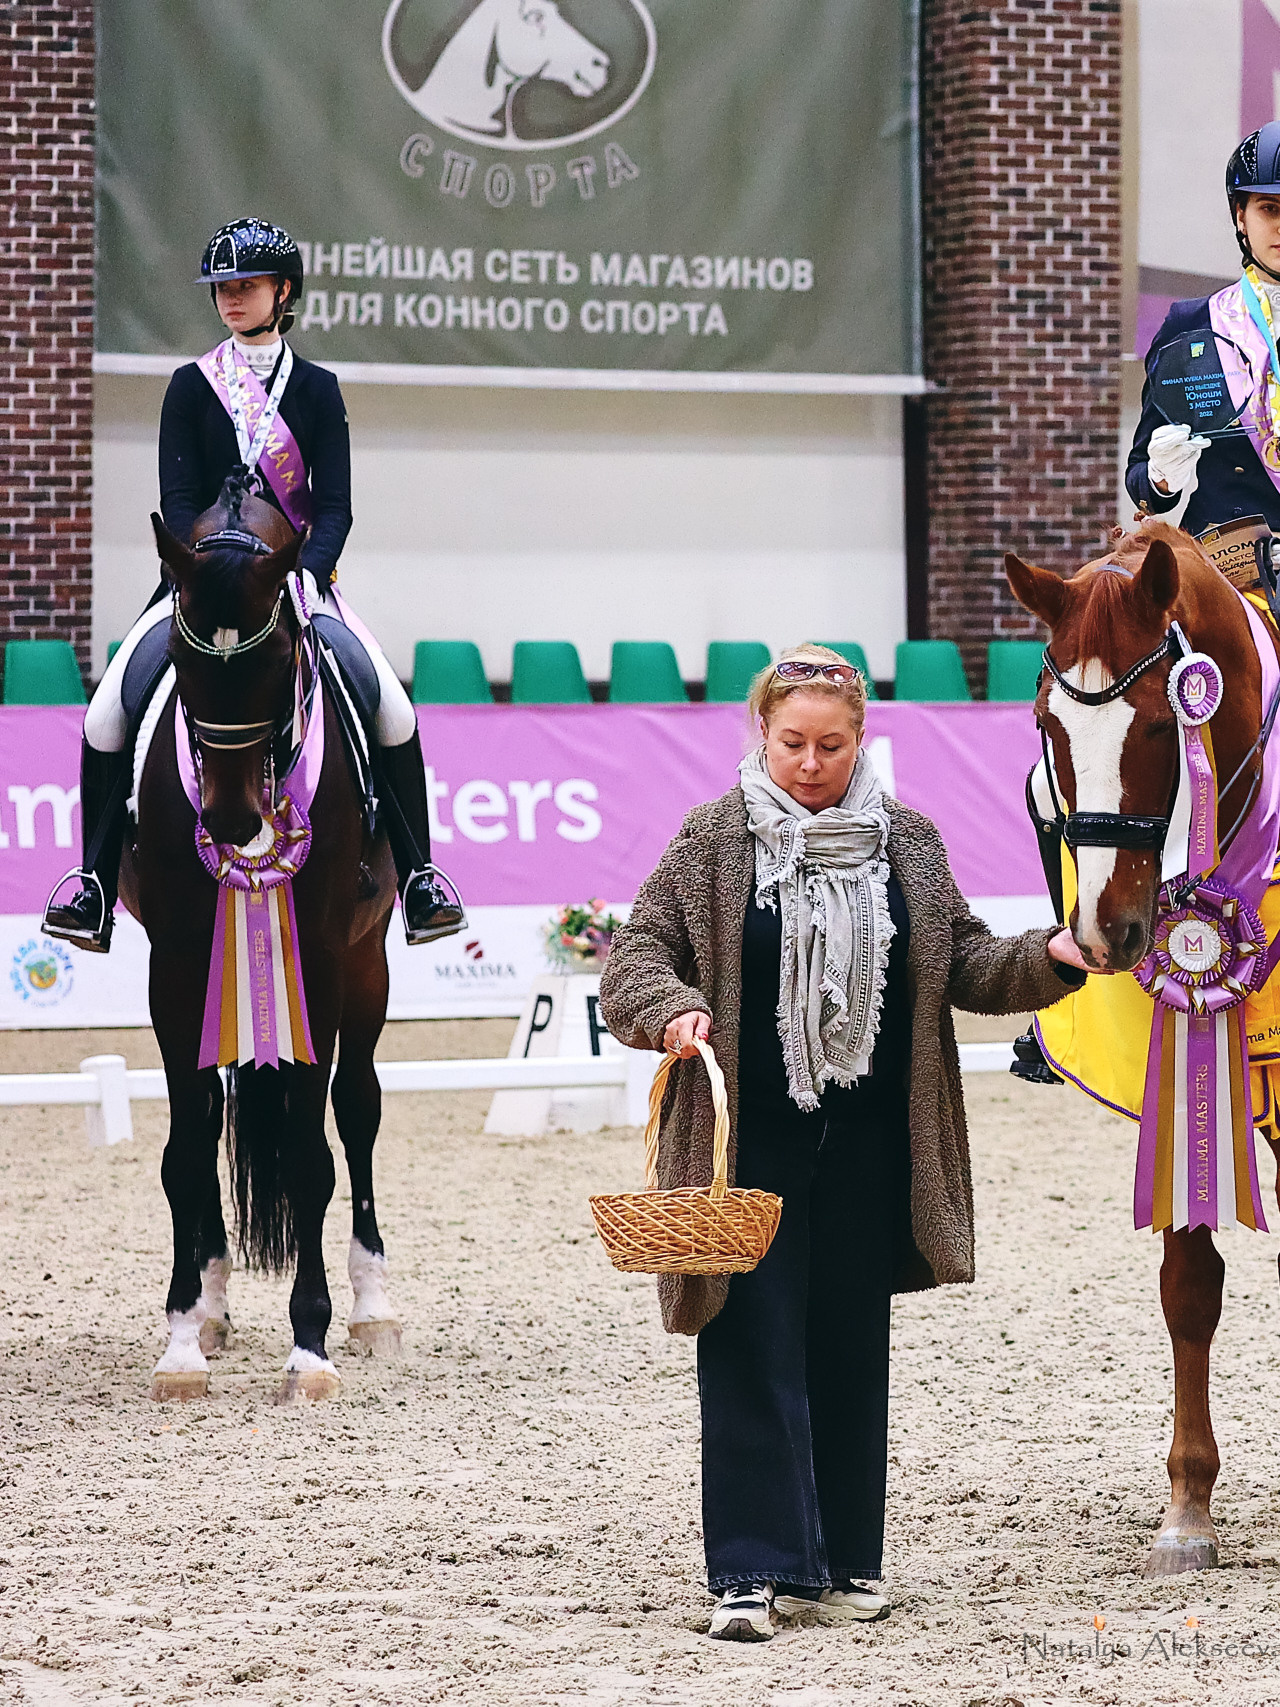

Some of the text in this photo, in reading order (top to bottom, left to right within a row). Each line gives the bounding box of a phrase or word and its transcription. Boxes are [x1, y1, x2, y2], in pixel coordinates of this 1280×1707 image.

[400, 133, 640, 208] СПОРТА
[484, 249, 581, 285] СЕТЬ
[590, 252, 815, 291] МАГАЗИНОВ
[302, 290, 729, 336] ДЛЯ КОННОГО СПОРТА
[1195, 399, 1221, 409] МЕСТО
[434, 963, 516, 979] MAXIMA
[523, 993, 553, 1058] P
[1196, 1064, 1208, 1203] MAXIMA MASTERS
